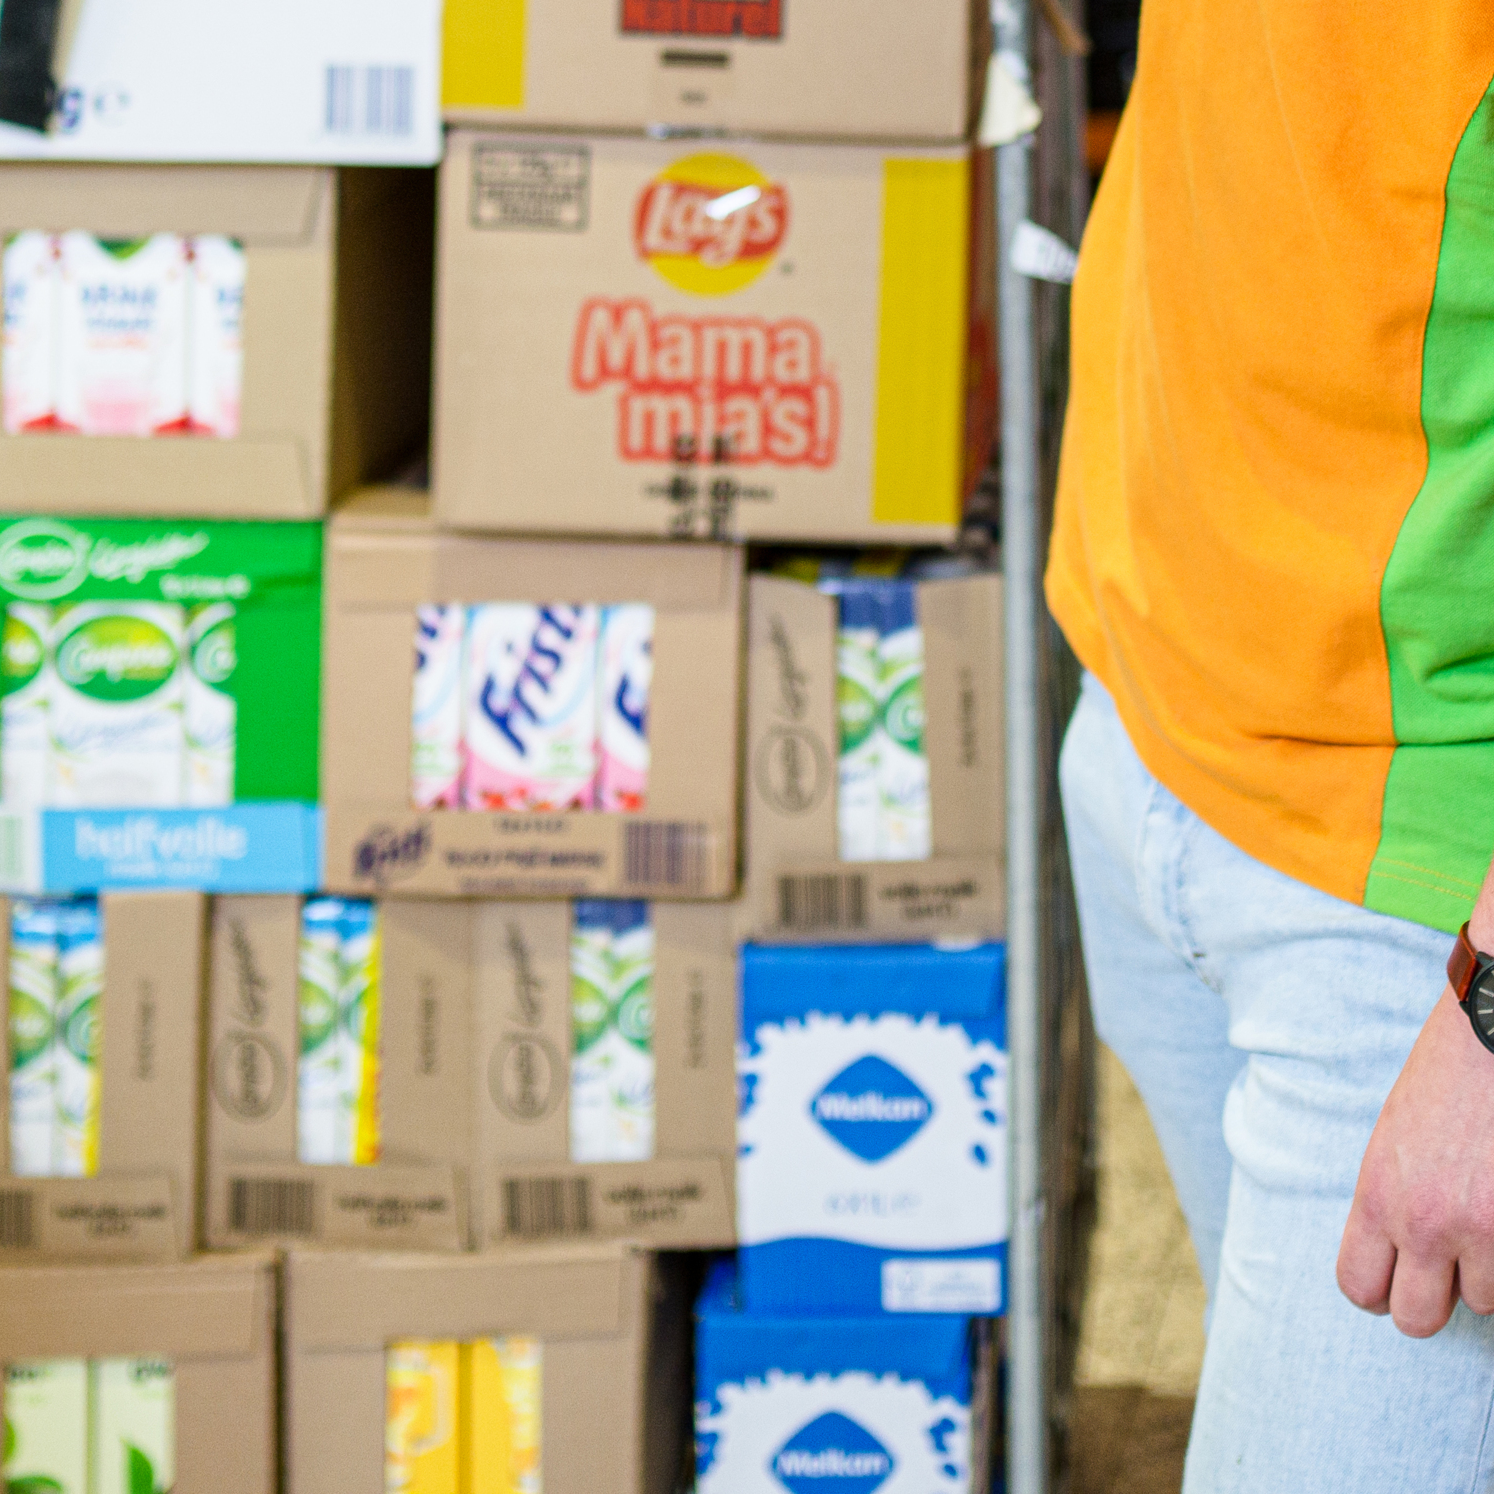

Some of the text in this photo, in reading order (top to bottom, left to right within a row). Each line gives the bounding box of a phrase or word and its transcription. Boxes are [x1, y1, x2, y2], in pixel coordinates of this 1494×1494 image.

[571, 294, 824, 392] Mama
[617, 372, 841, 472] mia's!
[75, 816, 248, 862] halfvolle
[817, 1091, 928, 1123] Melkan
[777, 1448, 891, 1478] Melkan
